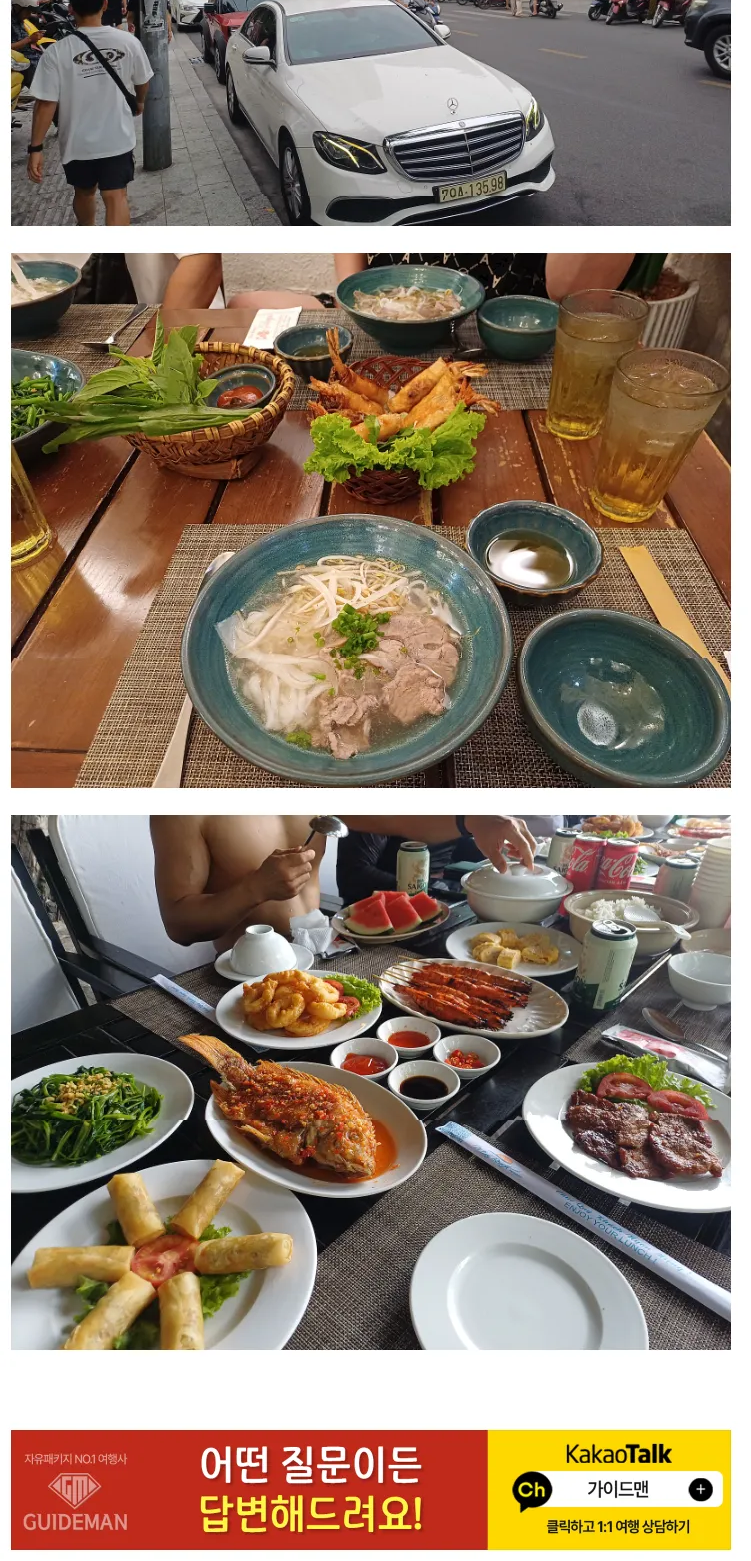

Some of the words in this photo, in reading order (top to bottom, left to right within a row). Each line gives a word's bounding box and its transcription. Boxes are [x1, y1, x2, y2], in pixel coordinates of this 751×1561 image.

[564, 1202, 592, 1221] ENJOY
[593, 1219, 618, 1239] YOUR
[618, 1236, 652, 1260] LUNCH
